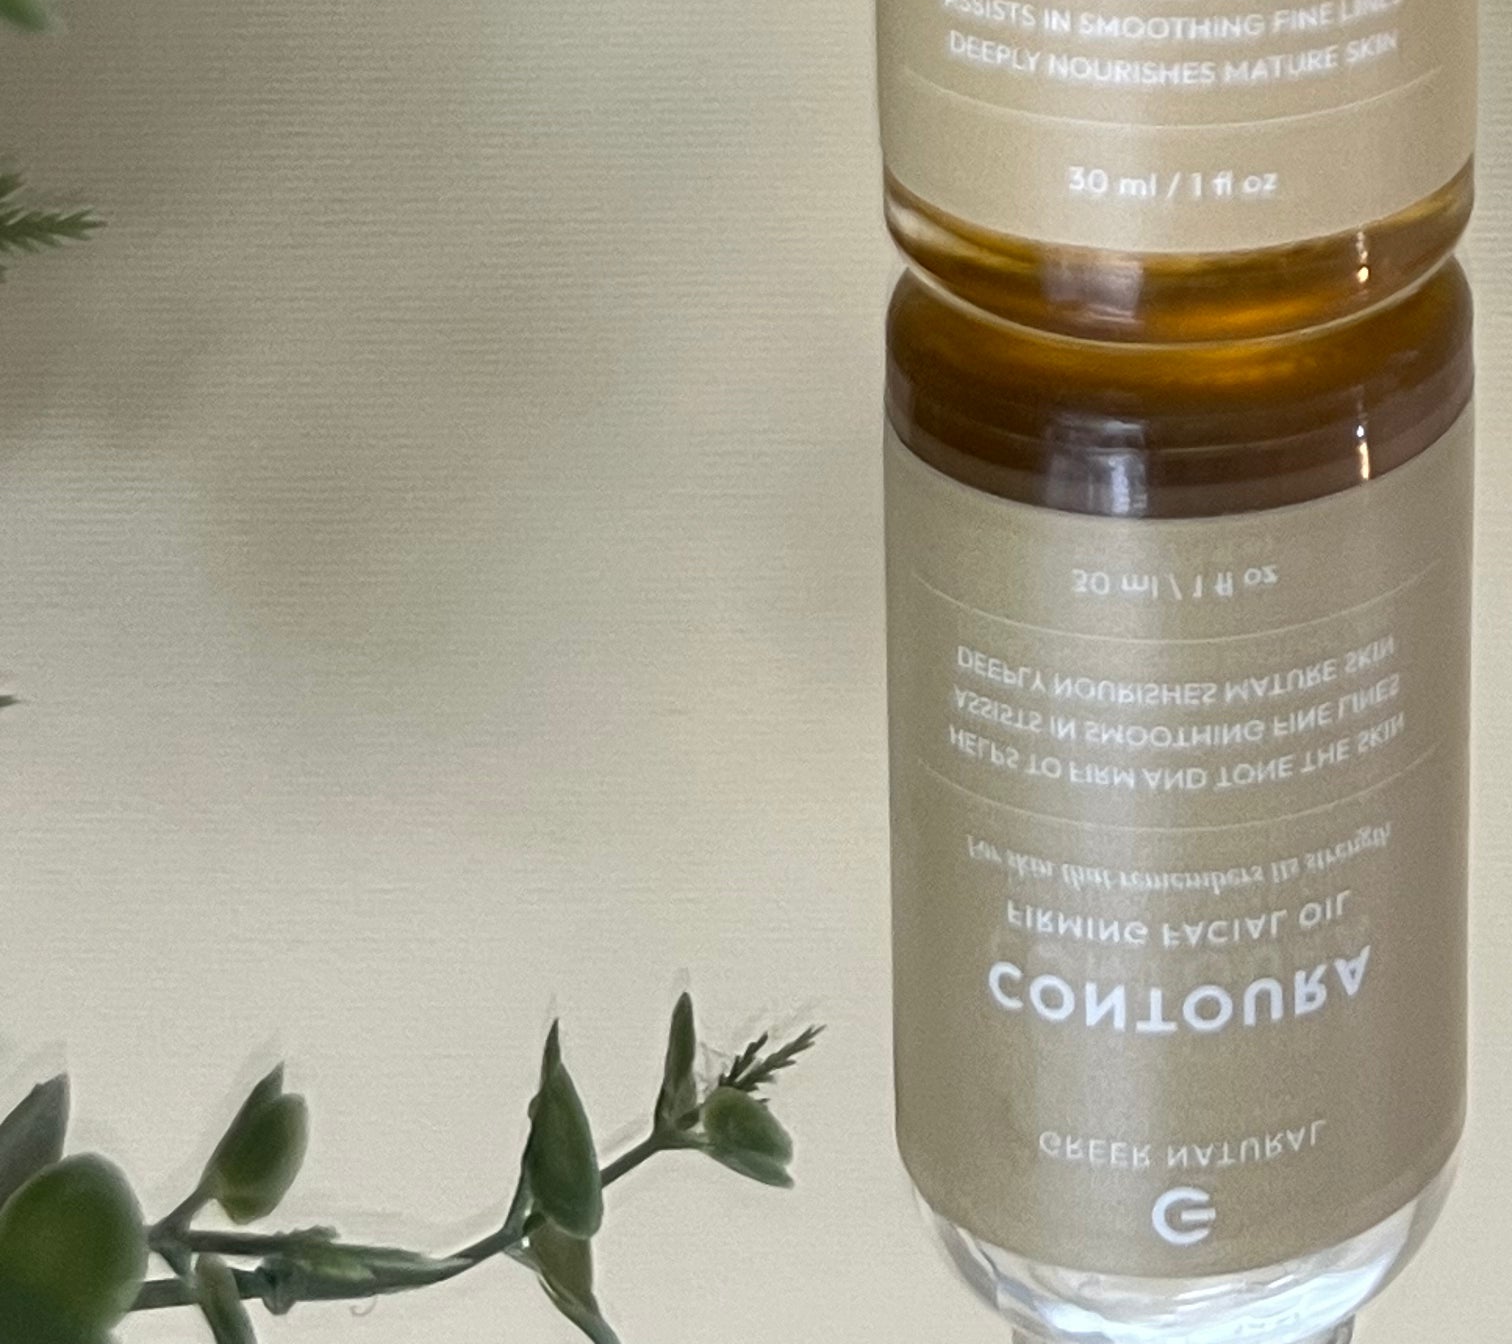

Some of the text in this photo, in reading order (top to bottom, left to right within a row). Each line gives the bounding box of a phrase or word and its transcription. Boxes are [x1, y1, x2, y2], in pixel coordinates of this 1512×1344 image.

[1045, 9, 1070, 31] IN
[1080, 15, 1264, 39] SMOOTHING
[1273, 4, 1330, 31] FINE
[950, 29, 1397, 84] DEEPLY NOURISHES MATURE SKIN
[1068, 167, 1108, 193] 30
[1120, 173, 1157, 196] ml
[1213, 172, 1232, 194] fl
[1243, 174, 1278, 193] oz
